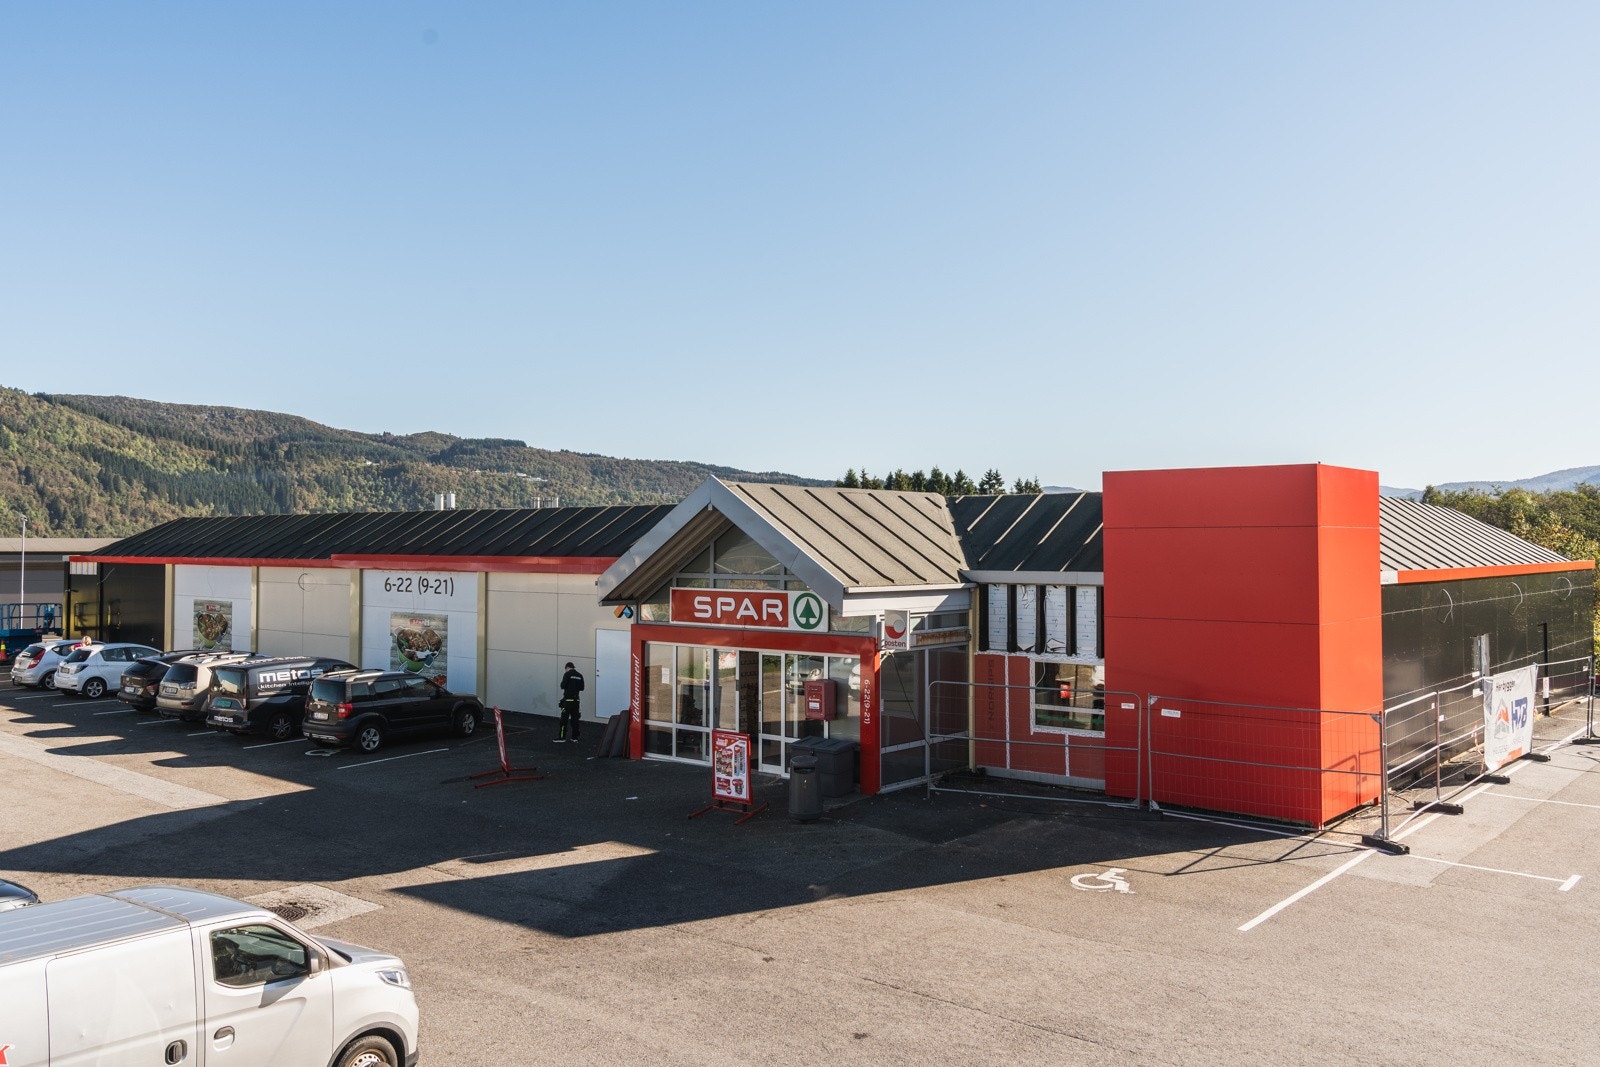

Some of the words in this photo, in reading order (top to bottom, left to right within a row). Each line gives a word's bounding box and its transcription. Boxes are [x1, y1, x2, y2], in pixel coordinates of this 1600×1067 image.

[384, 577, 413, 592] 6-22
[418, 576, 454, 597] (9-21)
[693, 596, 784, 622] SPAR
[884, 640, 907, 648] posten
[259, 669, 324, 683] metos
[632, 653, 640, 723] Velkommen!
[863, 679, 871, 725] 6-22(9-21)
